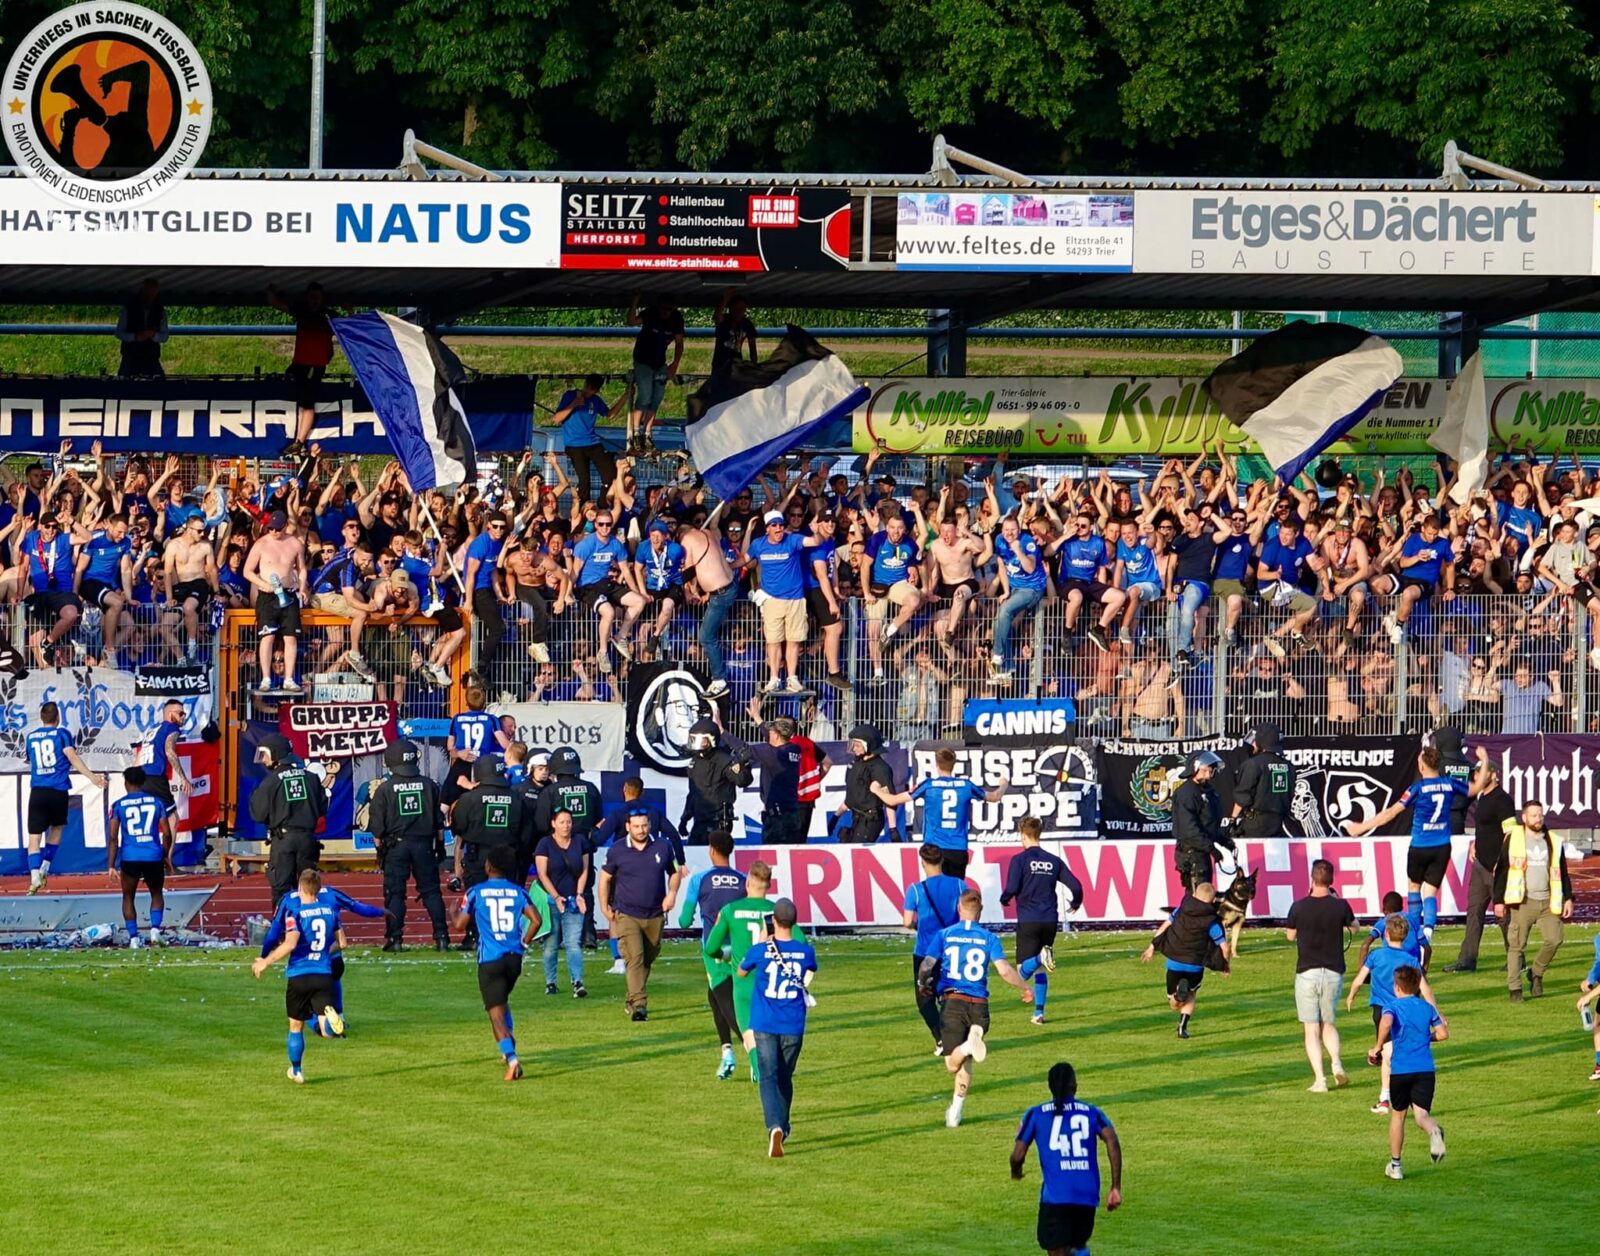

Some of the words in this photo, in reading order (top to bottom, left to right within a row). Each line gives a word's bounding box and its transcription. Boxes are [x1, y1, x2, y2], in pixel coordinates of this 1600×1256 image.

[568, 194, 646, 218] SEITZ
[670, 195, 725, 207] Hallenbau
[265, 211, 312, 234] BEI
[336, 203, 532, 244] NATUS
[567, 220, 646, 230] STAHLBAU
[669, 215, 745, 227] Stahlhochbau
[1192, 196, 1537, 248] Etges&Dächert
[573, 234, 638, 244] HERFORST
[669, 235, 738, 247] Industriebau
[897, 235, 1056, 256] www.feltes.de
[1065, 236, 1111, 246] Eltzstraße
[1113, 237, 1124, 246] 41
[1065, 247, 1093, 256] 54293
[1095, 247, 1116, 256] Trier
[1191, 250, 1536, 271] BAUSTOFFE
[627, 258, 740, 269] www.seitz-stahlbau.de
[1001, 388, 1047, 398] Trier-Galerie
[889, 390, 995, 433] Kylltal
[996, 401, 1019, 410] 0651
[1026, 401, 1040, 410] 99
[1041, 401, 1054, 410] 46
[1055, 401, 1067, 410] 09
[1513, 390, 1600, 433] Kyllta
[1367, 417, 1383, 428] die
[1385, 418, 1426, 428] Nummer
[943, 425, 1024, 448] REISEBÜRO
[136, 674, 208, 690] FANATICS
[291, 703, 391, 731] GRUPPA
[976, 710, 1067, 736] CANNIS
[308, 730, 387, 757] METZ
[461, 723, 484, 751] 19
[1104, 740, 1180, 756] SCHWEICH
[1182, 737, 1238, 754] UNITED
[31, 740, 57, 770] 18
[402, 752, 416, 762] RP
[563, 752, 576, 760] RP
[1444, 765, 1470, 774] POLIZEI
[393, 782, 424, 792] POLIZEI
[558, 785, 588, 796] POLIZEI
[482, 795, 512, 804] POLIZEI
[942, 789, 957, 819] 2
[1430, 793, 1445, 823] 7
[125, 804, 156, 836] 27
[1105, 820, 1141, 832] YOU'LL
[1030, 861, 1053, 873] gap
[711, 875, 740, 890] gap
[734, 847, 1014, 923] ERNT
[485, 897, 515, 932] 15
[310, 918, 326, 951] 3
[945, 945, 986, 983] 18
[764, 961, 802, 1000] 12
[1049, 1114, 1090, 1158] 42
